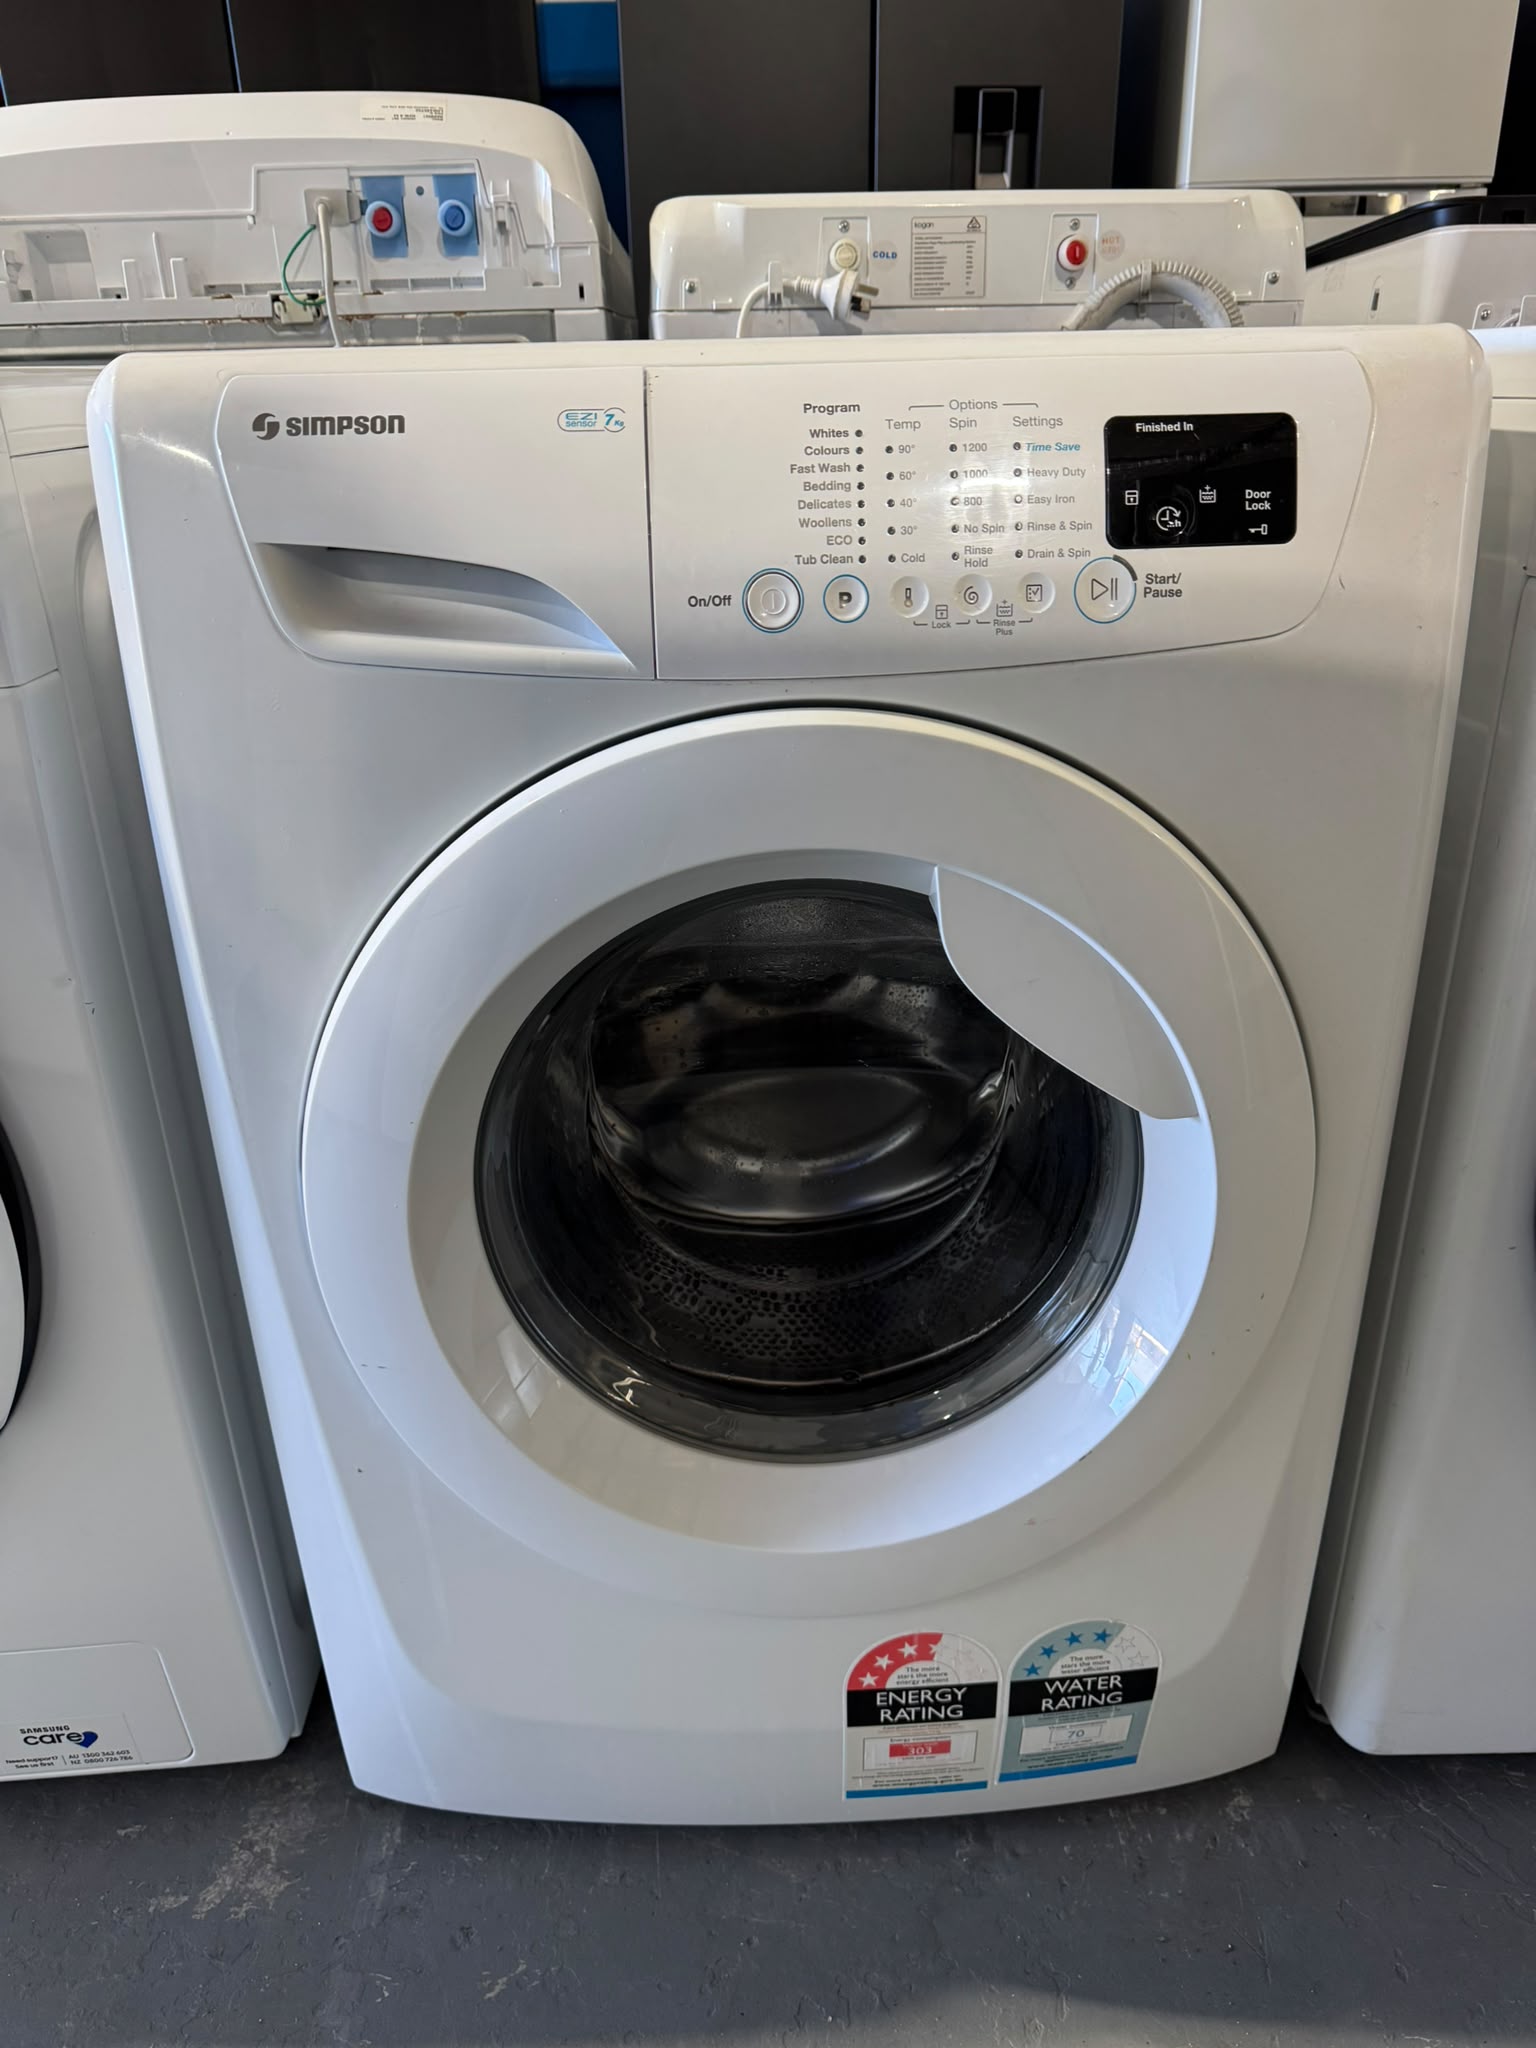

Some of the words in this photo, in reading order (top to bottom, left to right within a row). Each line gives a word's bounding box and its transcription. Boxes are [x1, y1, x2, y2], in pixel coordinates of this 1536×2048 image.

[872, 250, 898, 260] COLD
[803, 403, 861, 416] Program
[949, 399, 998, 412] Options
[565, 412, 598, 420] EZI
[605, 413, 615, 426] 7
[286, 414, 406, 437] SIMPSON
[885, 419, 921, 432] Temp
[949, 417, 977, 430] Spin
[1012, 416, 1063, 429] Settings
[1136, 422, 1181, 432] Finished
[1183, 422, 1194, 431] In
[809, 428, 850, 438] Whites
[804, 446, 850, 456] Colours
[962, 443, 988, 452] 1200
[1025, 442, 1052, 451] Time
[1054, 442, 1081, 451] Save
[790, 463, 816, 474] Fast
[818, 462, 851, 473] Wash
[963, 469, 989, 479] 1000
[1027, 468, 1059, 479] Heavy
[1062, 467, 1087, 478] Duty
[803, 480, 852, 492] Bedding
[1027, 494, 1052, 506] Easy
[1055, 494, 1076, 503] Iron
[1245, 489, 1272, 499] Door
[797, 499, 852, 510] Delicates
[963, 497, 983, 506] 800
[1245, 501, 1272, 510] Lock
[798, 517, 853, 528] Woollens
[1027, 521, 1056, 531] Rinse
[1059, 520, 1067, 530] &
[1069, 520, 1093, 532] Spin
[963, 524, 979, 533] No
[981, 523, 1005, 535] Spin
[826, 535, 853, 546] ECO
[964, 545, 994, 555] Rinse
[1027, 548, 1055, 558] Drain
[1057, 548, 1065, 558] &
[1067, 547, 1091, 559] Spin
[794, 554, 817, 565] Tub
[820, 553, 854, 564] Clean
[901, 553, 926, 563] Cold
[964, 558, 989, 568] Hold
[1145, 572, 1182, 585] Start/
[1143, 586, 1183, 598] Pause
[687, 595, 732, 607] On/Off
[838, 591, 853, 609] P
[931, 621, 952, 629] Lock
[993, 618, 1016, 627] Rinse
[995, 627, 1014, 636] Plus
[1044, 1675, 1123, 1694] WATER
[876, 1687, 968, 1706] ENERGY
[1041, 1692, 1123, 1712] RATING
[880, 1704, 964, 1723] RATING
[19, 1725, 70, 1735] SAMSUNG
[1067, 1729, 1085, 1739] 70
[23, 1731, 83, 1745] care
[908, 1746, 933, 1755] 303
